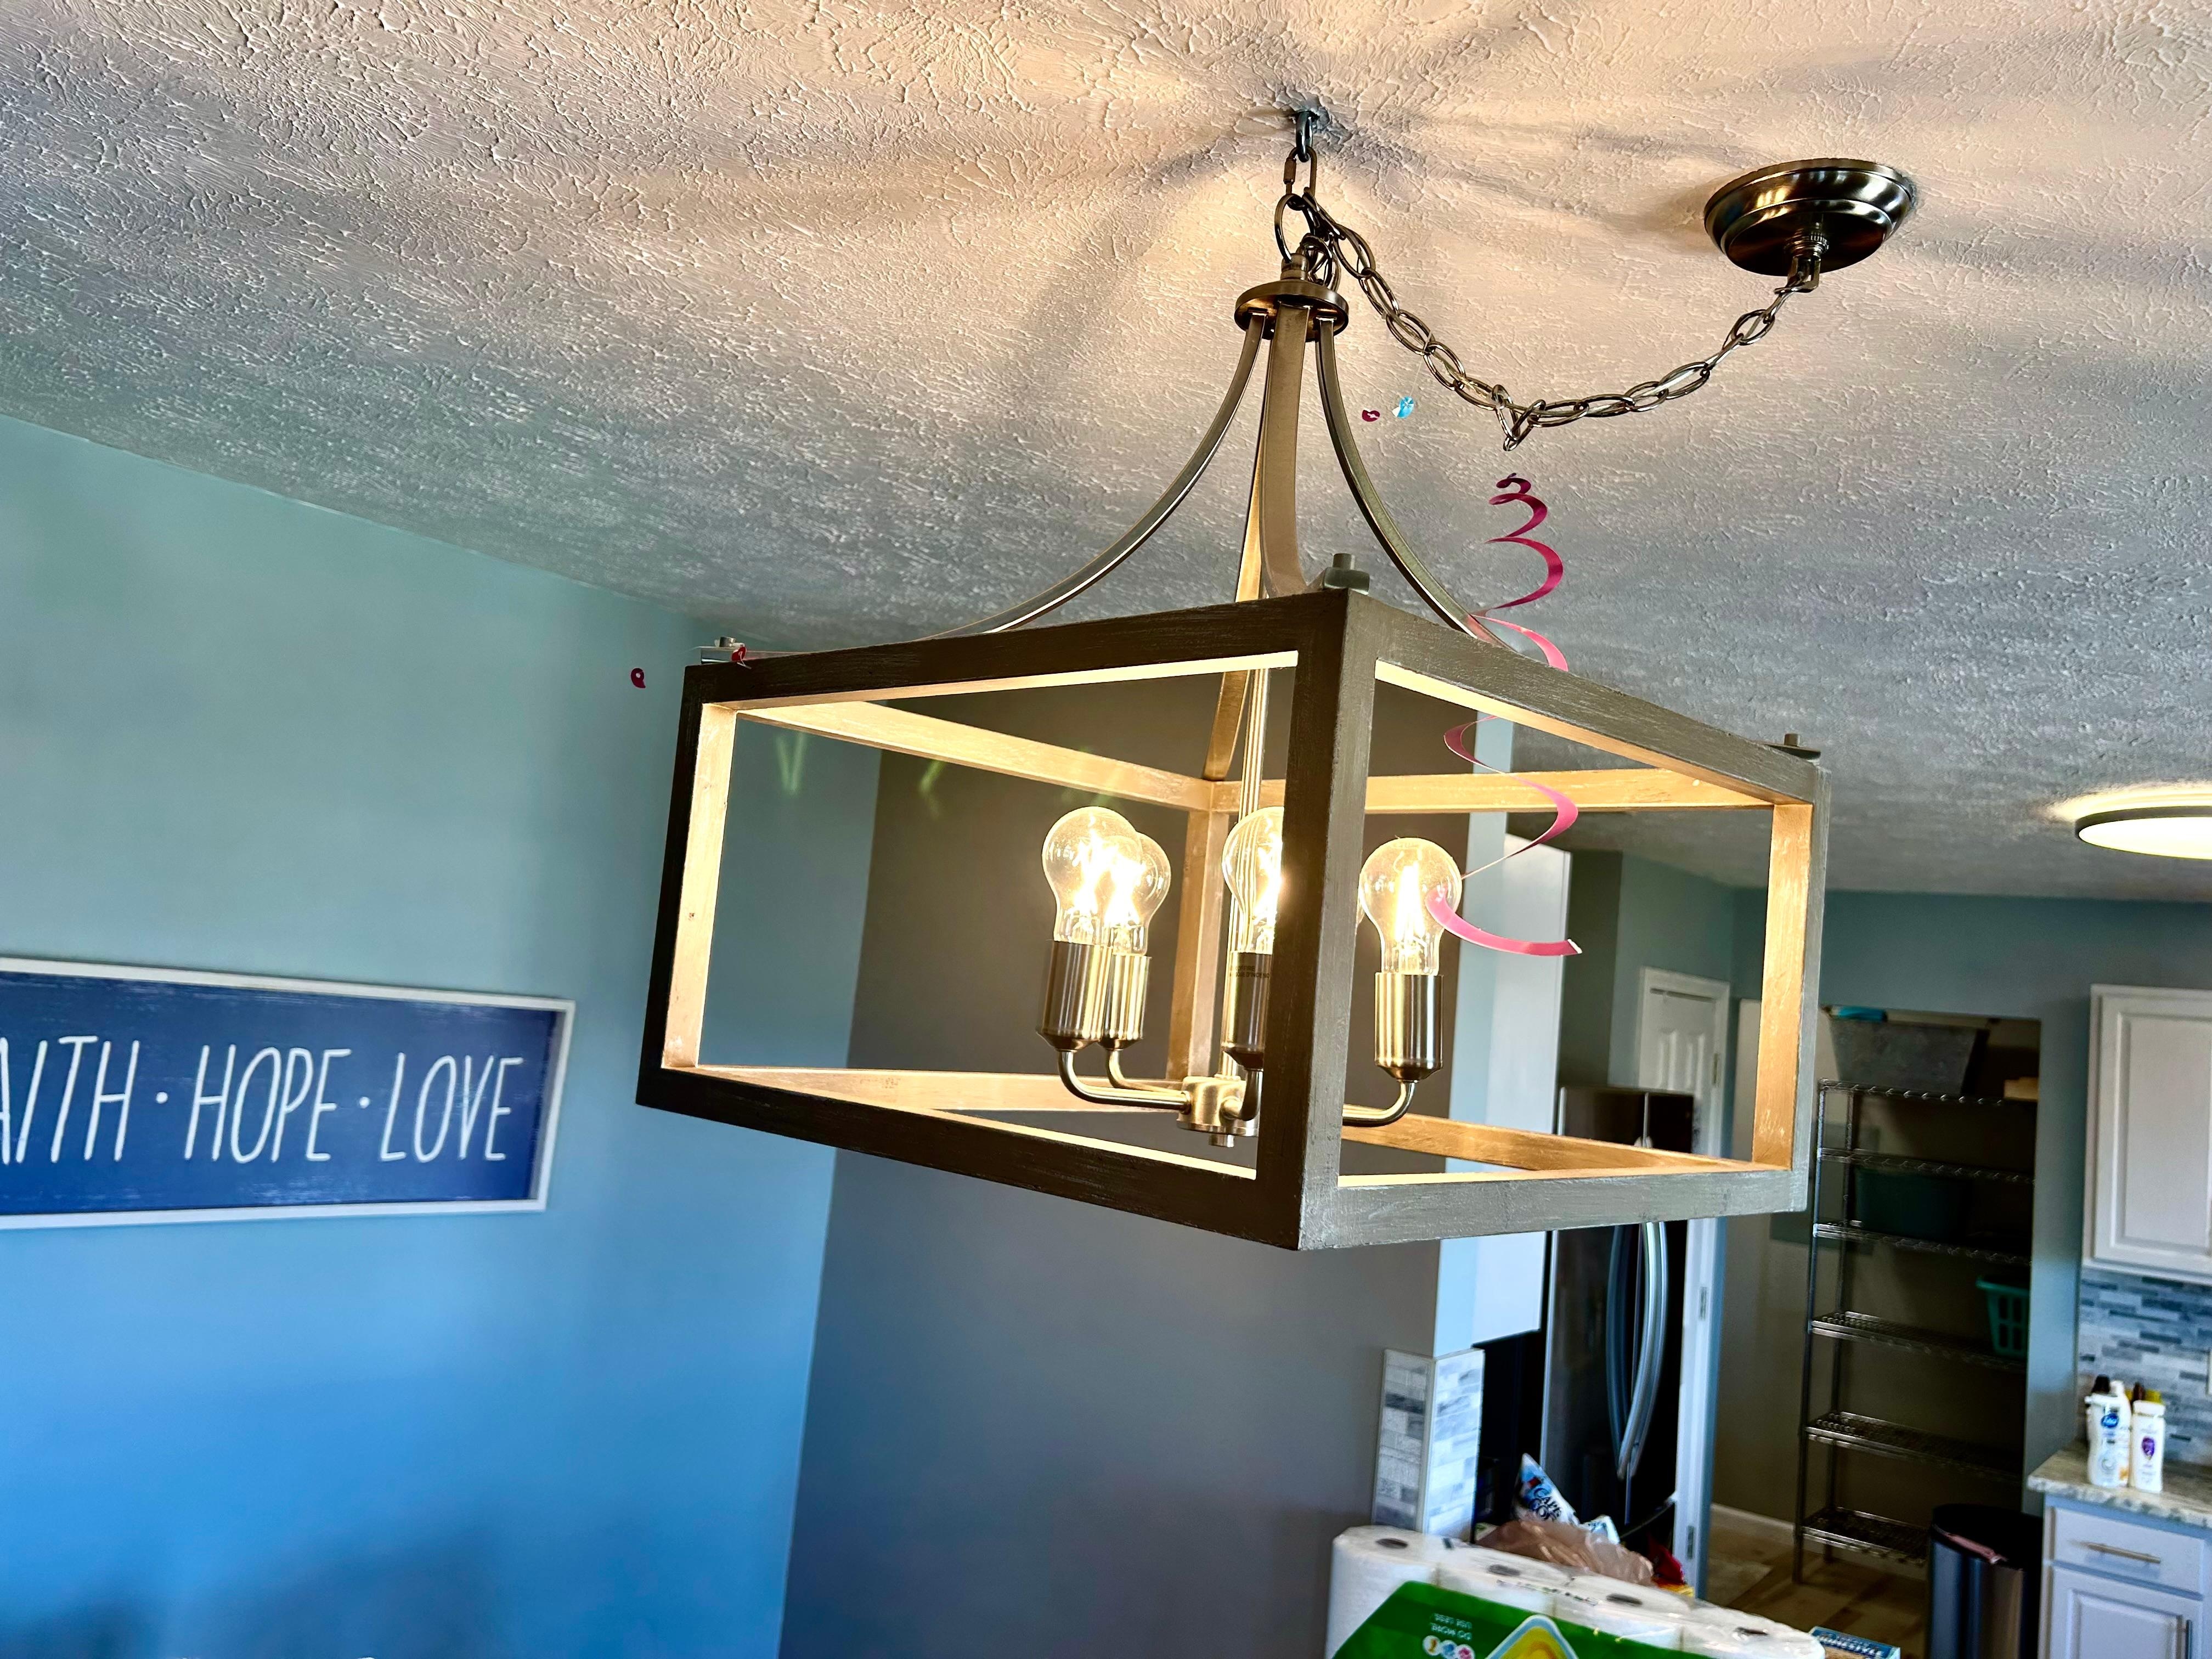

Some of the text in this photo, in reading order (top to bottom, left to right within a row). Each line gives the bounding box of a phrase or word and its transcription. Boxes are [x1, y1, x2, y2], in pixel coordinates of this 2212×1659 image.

[184, 1044, 352, 1163] HOPE
[380, 1052, 523, 1163] LOVE
[1533, 1487, 1561, 1517] CAPE
